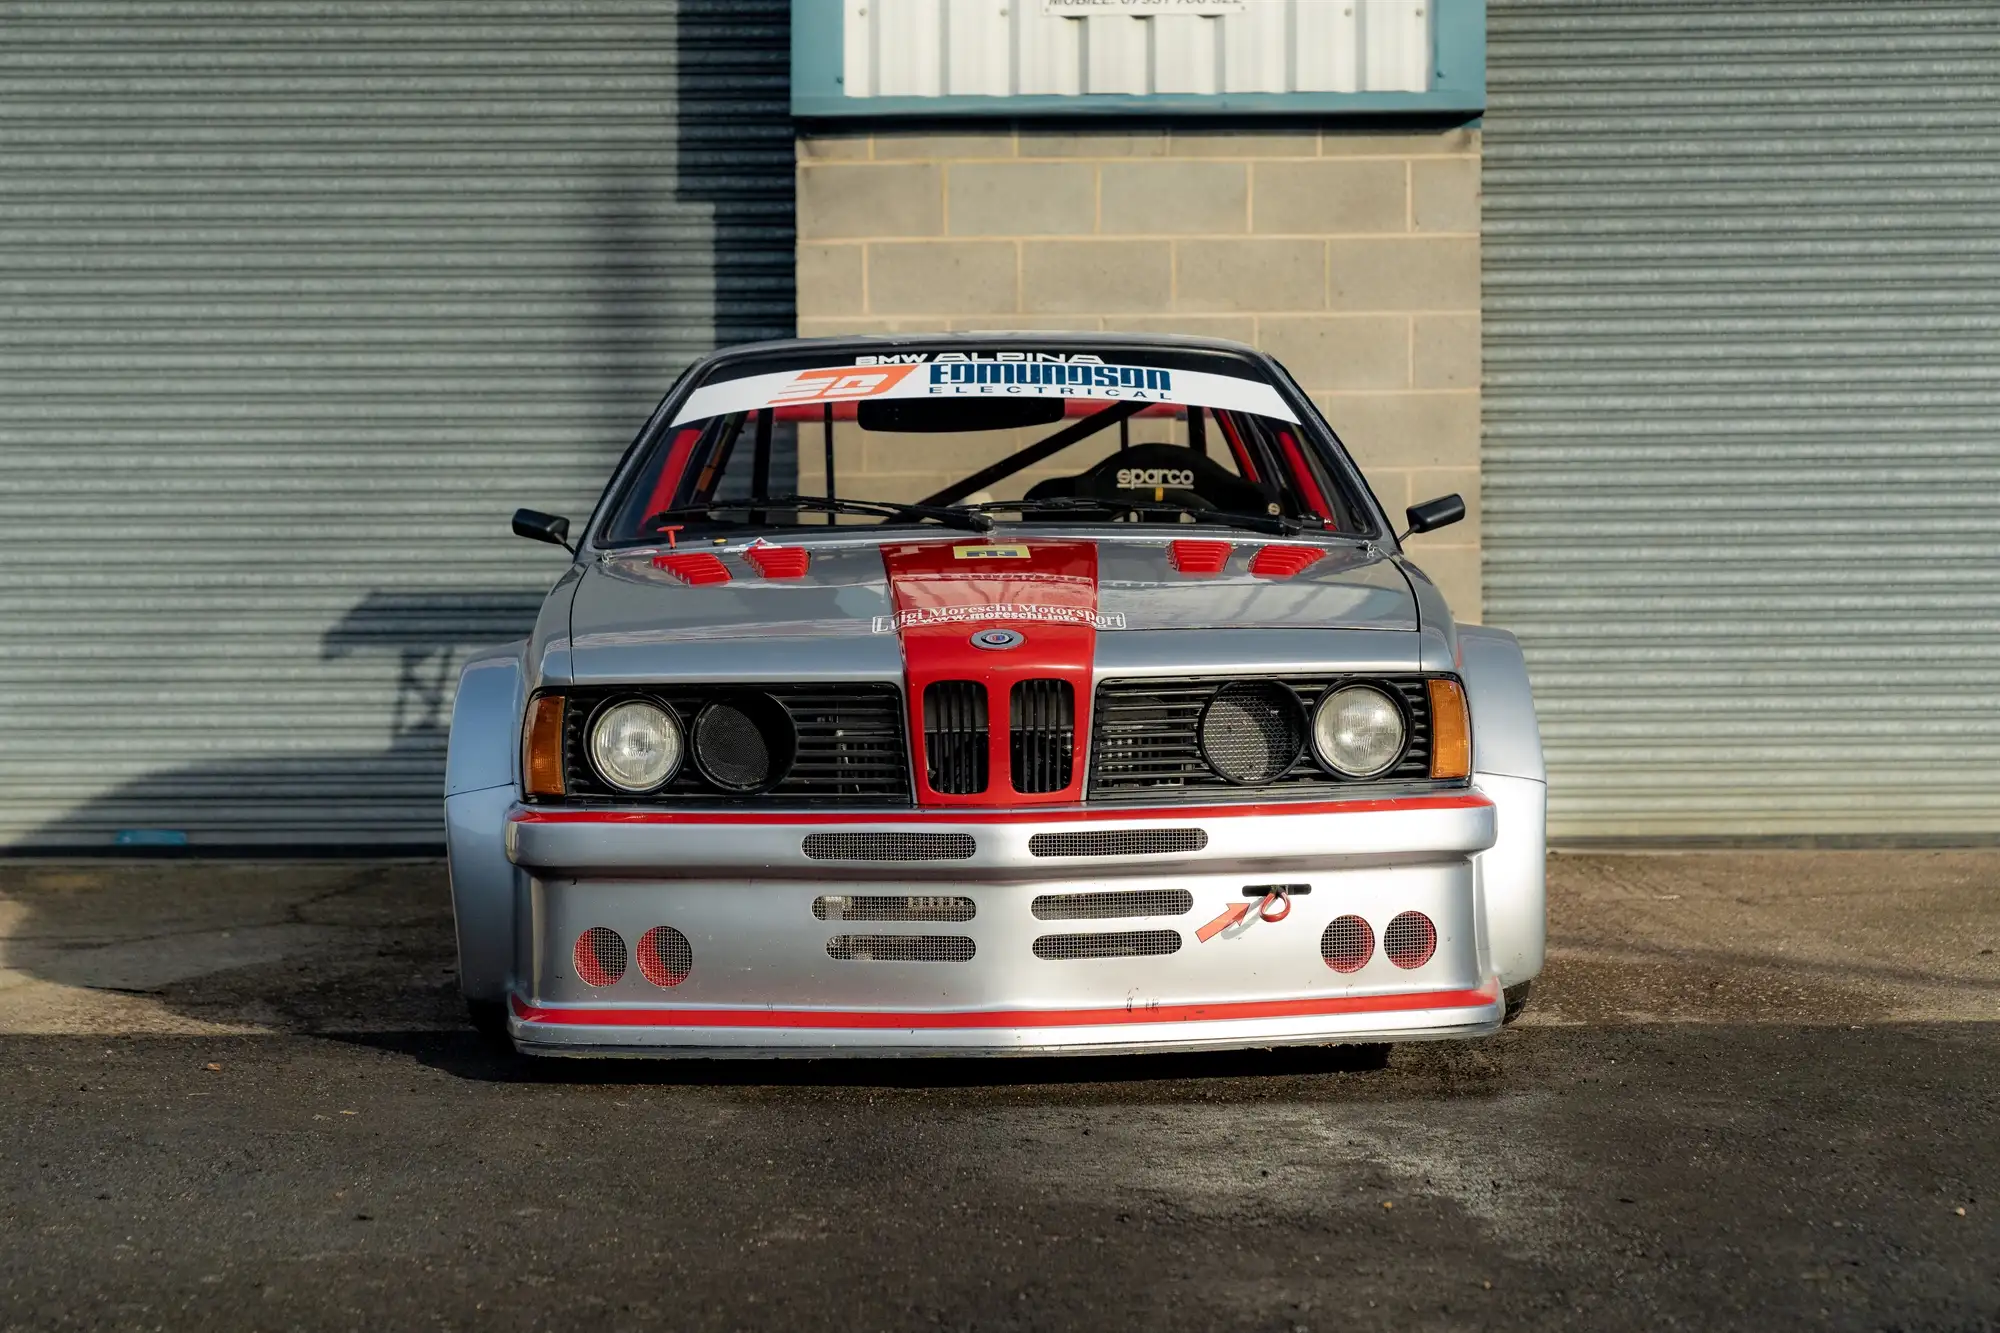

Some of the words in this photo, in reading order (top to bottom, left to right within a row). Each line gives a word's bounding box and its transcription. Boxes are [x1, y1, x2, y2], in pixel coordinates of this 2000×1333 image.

[856, 353, 928, 366] BMW
[933, 352, 1105, 365] ALPINA
[929, 386, 1172, 401] ELECTRICAL
[1117, 469, 1194, 489] sparco
[876, 609, 924, 632] Luigi
[928, 603, 1012, 619] Moreschi
[1018, 604, 1123, 627] Motorsport
[919, 611, 1079, 624] www.moreschi.info
